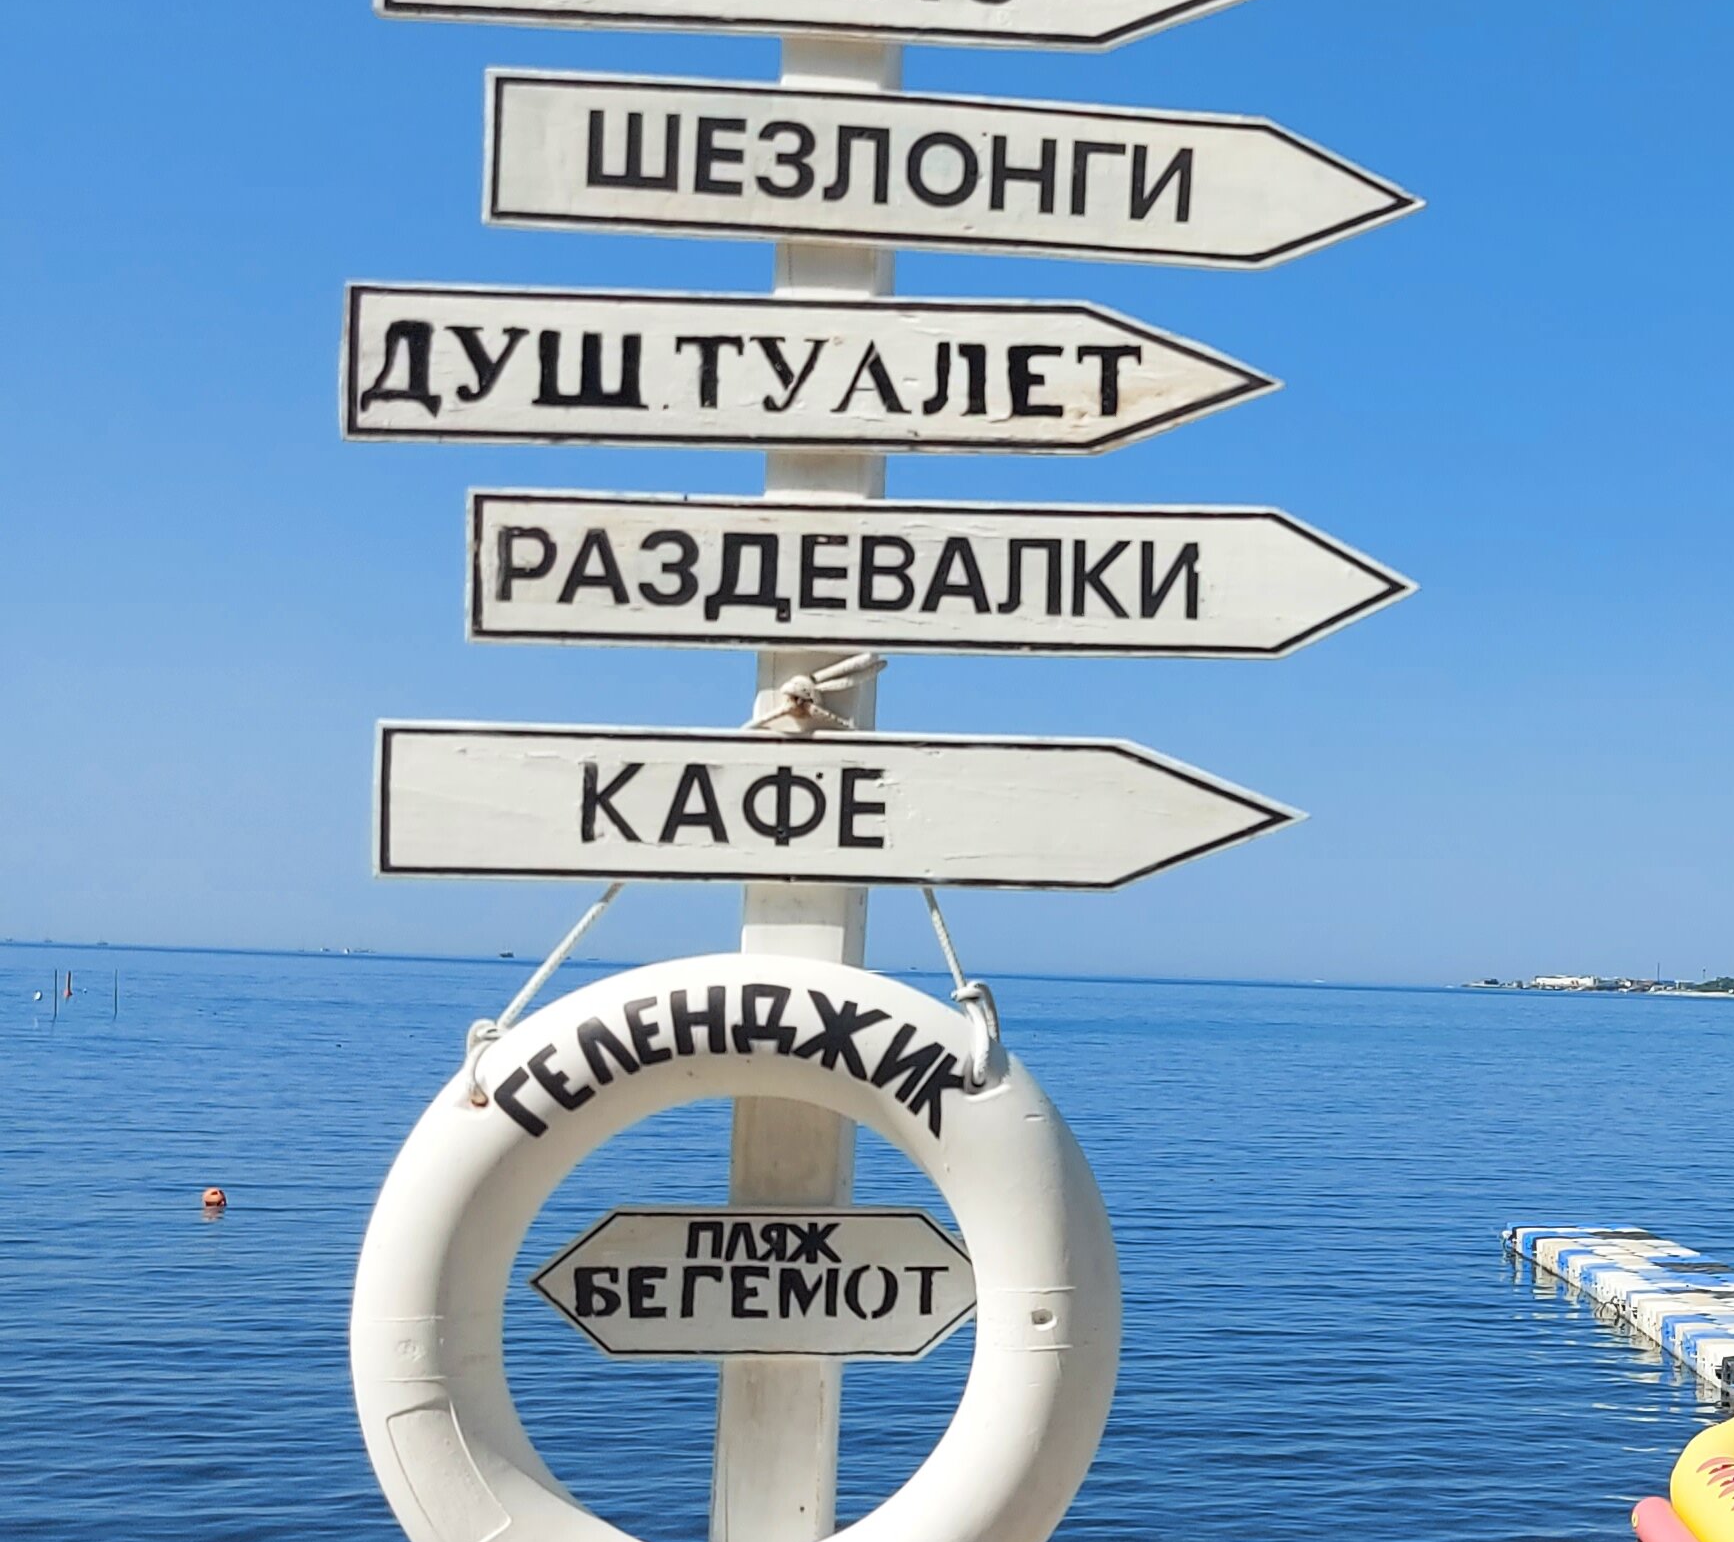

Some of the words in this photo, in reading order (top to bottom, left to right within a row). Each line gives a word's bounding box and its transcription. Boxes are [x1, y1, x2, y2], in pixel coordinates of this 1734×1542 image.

[586, 109, 1194, 223] ШЕЗЛОНГИ
[360, 319, 649, 418] ДУШ
[675, 335, 1142, 419] ТУАЛЕТ
[496, 525, 1200, 623] РАЗДЕВАЛКИ
[580, 762, 887, 849] КАФЕ
[494, 983, 966, 1140] ГЕЛЕНДЖИК
[685, 1220, 843, 1264] ПЛЯЖ
[573, 1264, 950, 1320] БЕГЕМОТ
